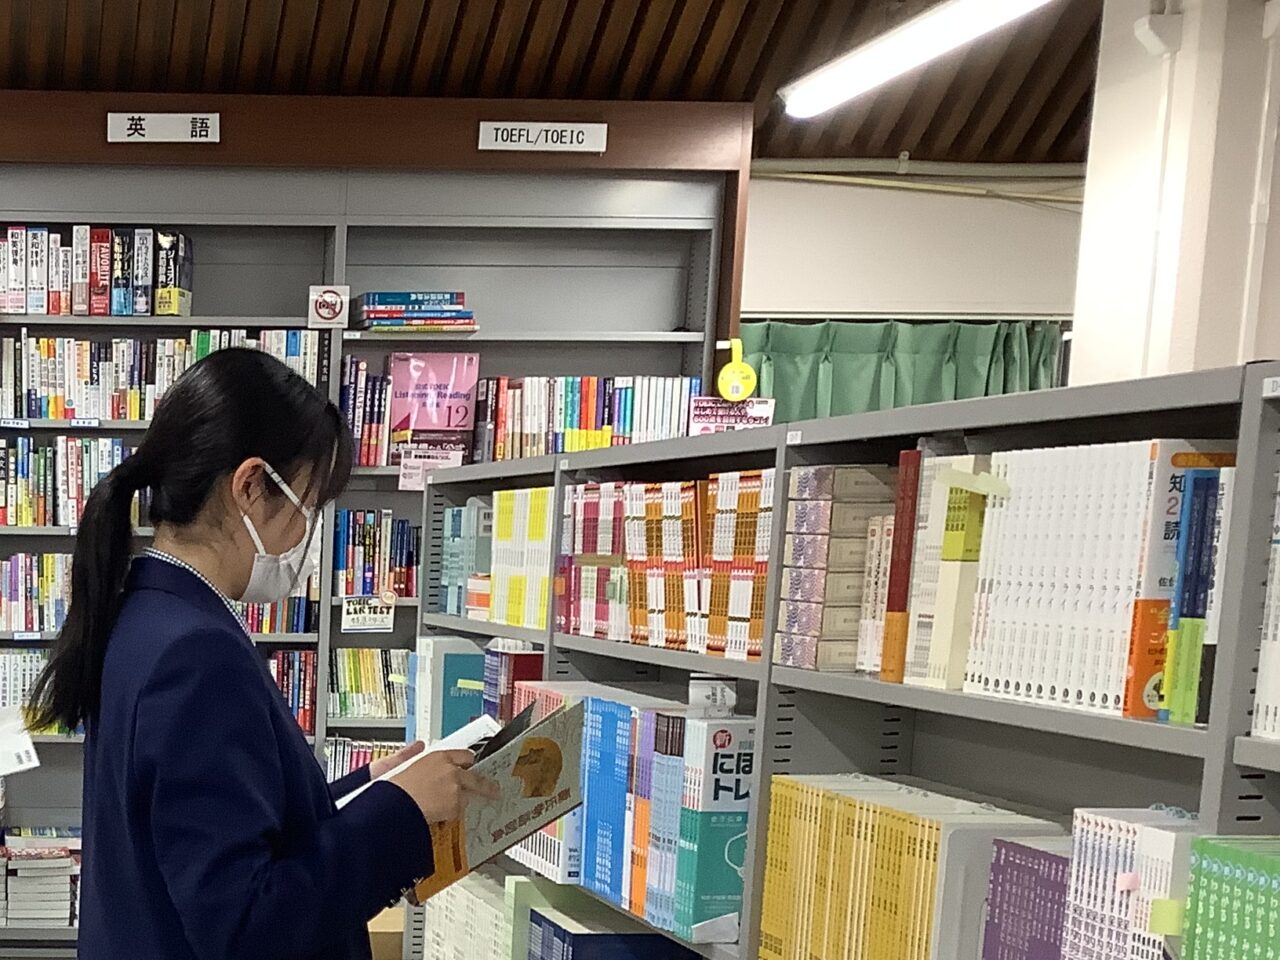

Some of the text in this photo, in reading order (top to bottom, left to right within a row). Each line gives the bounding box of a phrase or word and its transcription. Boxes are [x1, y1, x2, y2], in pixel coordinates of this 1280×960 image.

[493, 126, 586, 146] TOEFL/TOEIC
[445, 405, 469, 428] 12
[368, 605, 392, 615] TEST
